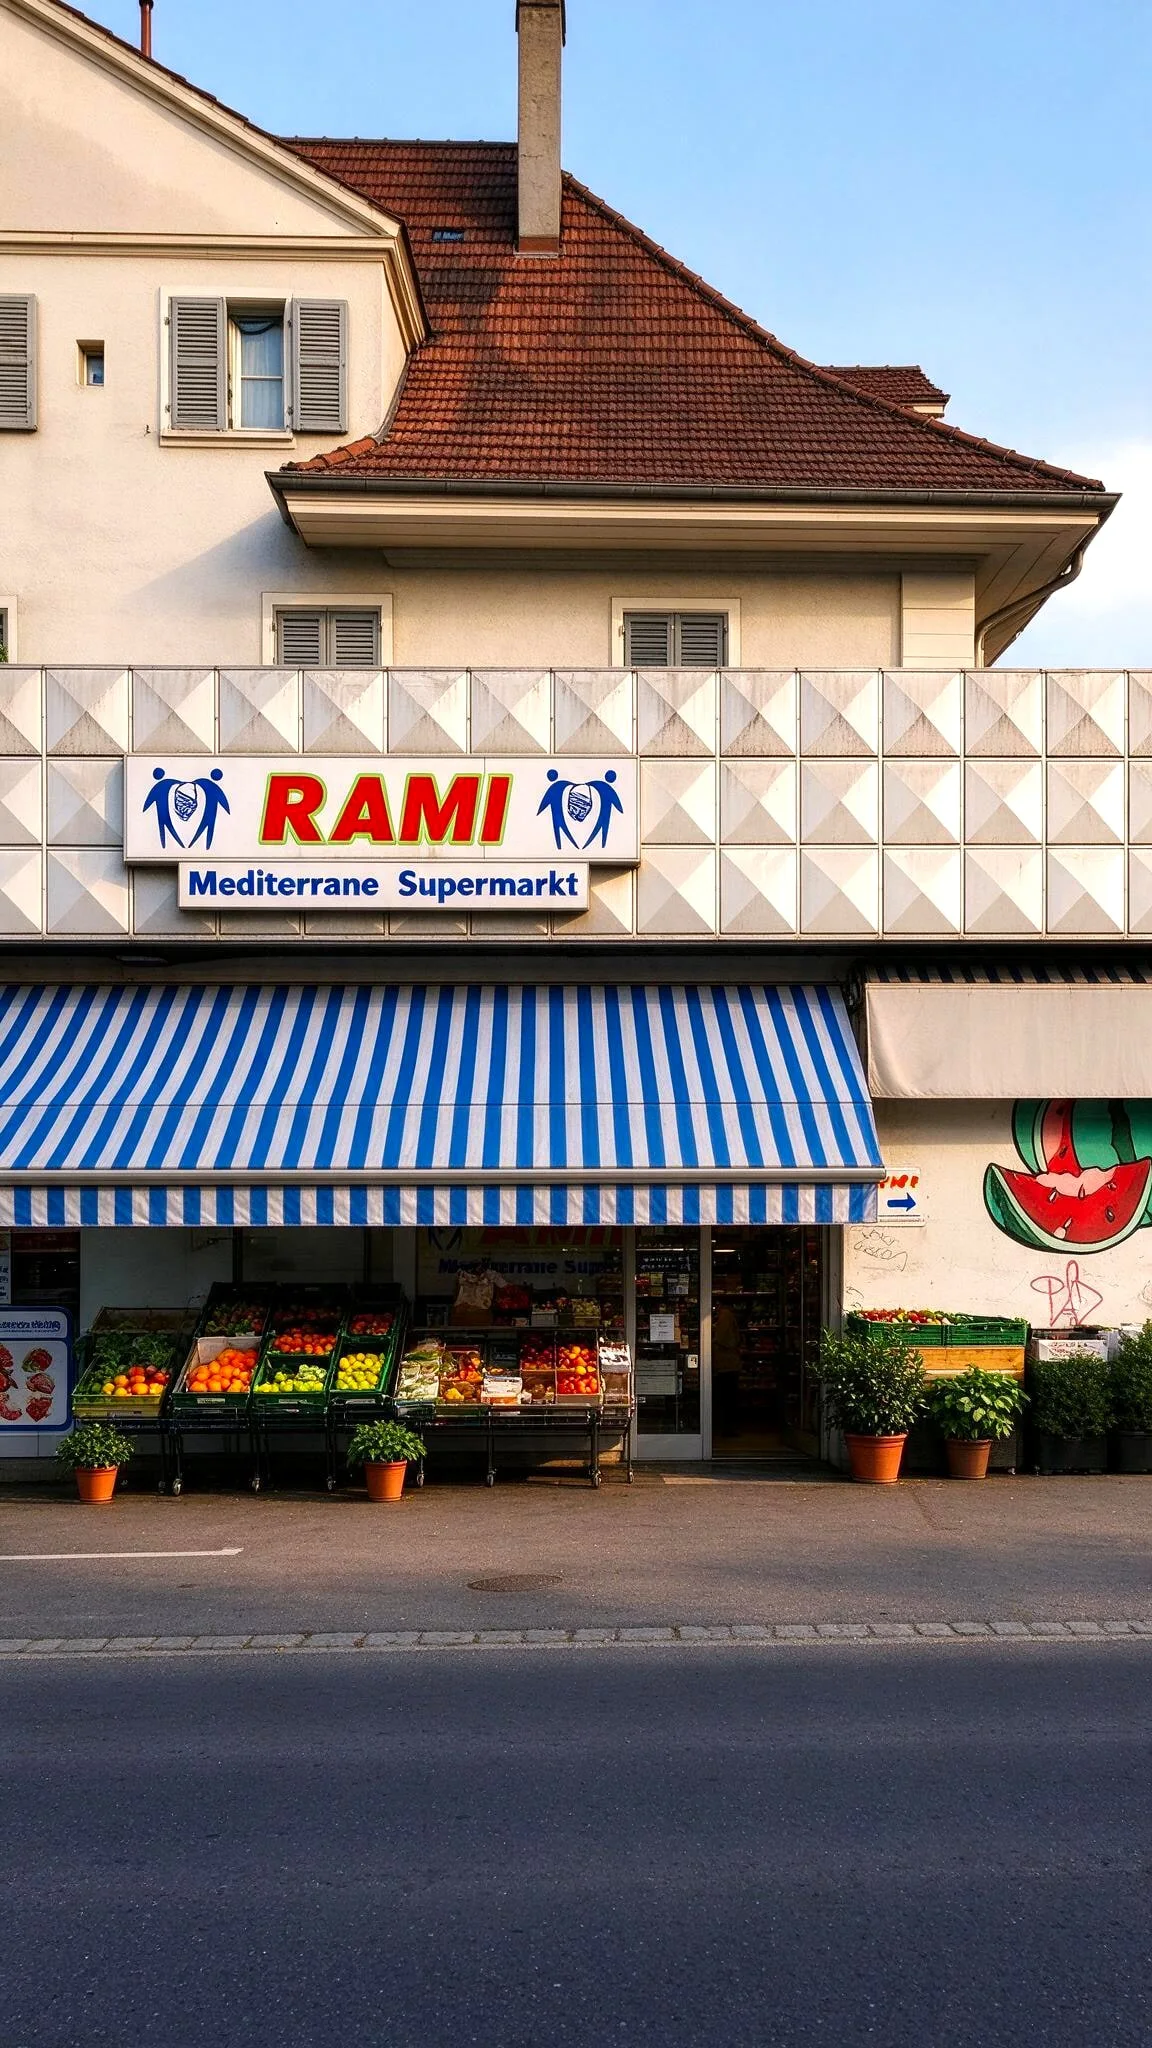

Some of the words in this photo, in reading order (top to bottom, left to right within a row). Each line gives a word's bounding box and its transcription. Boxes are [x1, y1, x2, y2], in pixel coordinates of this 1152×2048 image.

[258, 772, 513, 845] RAMI
[188, 870, 379, 897] Mediterrane
[398, 870, 578, 903] Supermarkt
